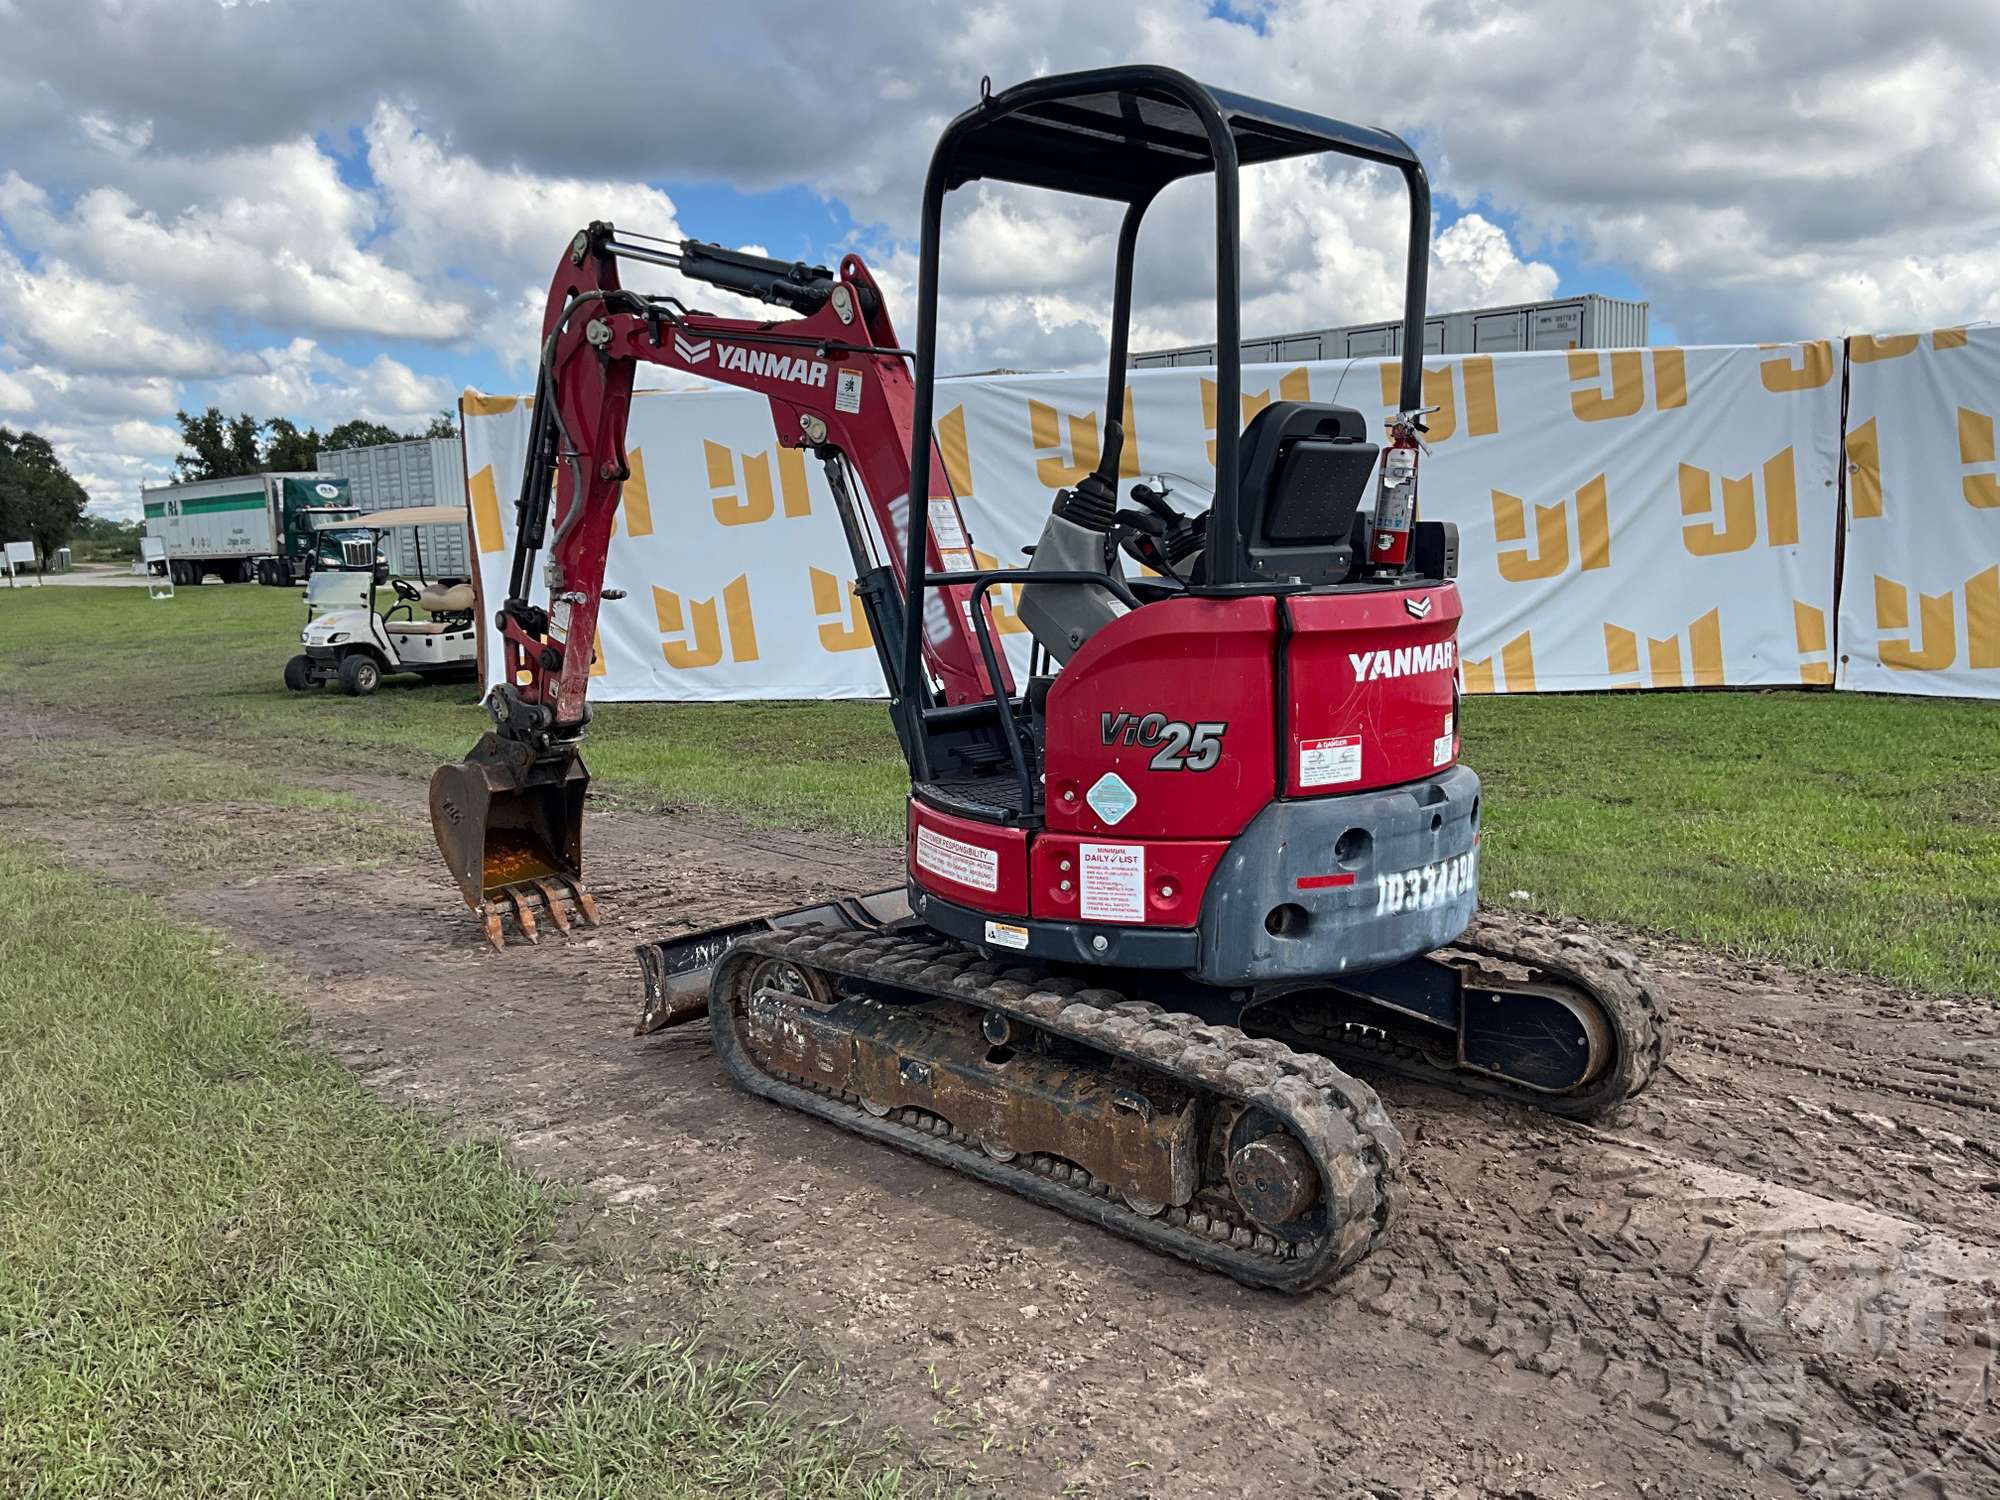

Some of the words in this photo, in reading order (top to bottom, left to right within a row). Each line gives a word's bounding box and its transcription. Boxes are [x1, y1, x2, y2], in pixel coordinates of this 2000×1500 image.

[716, 343, 828, 388] YANMAR
[1348, 641, 1454, 682] YANMAR
[943, 839, 988, 858] RESPONSIBILITY
[1084, 854, 1110, 863] DAILY
[1118, 855, 1138, 864] LIST
